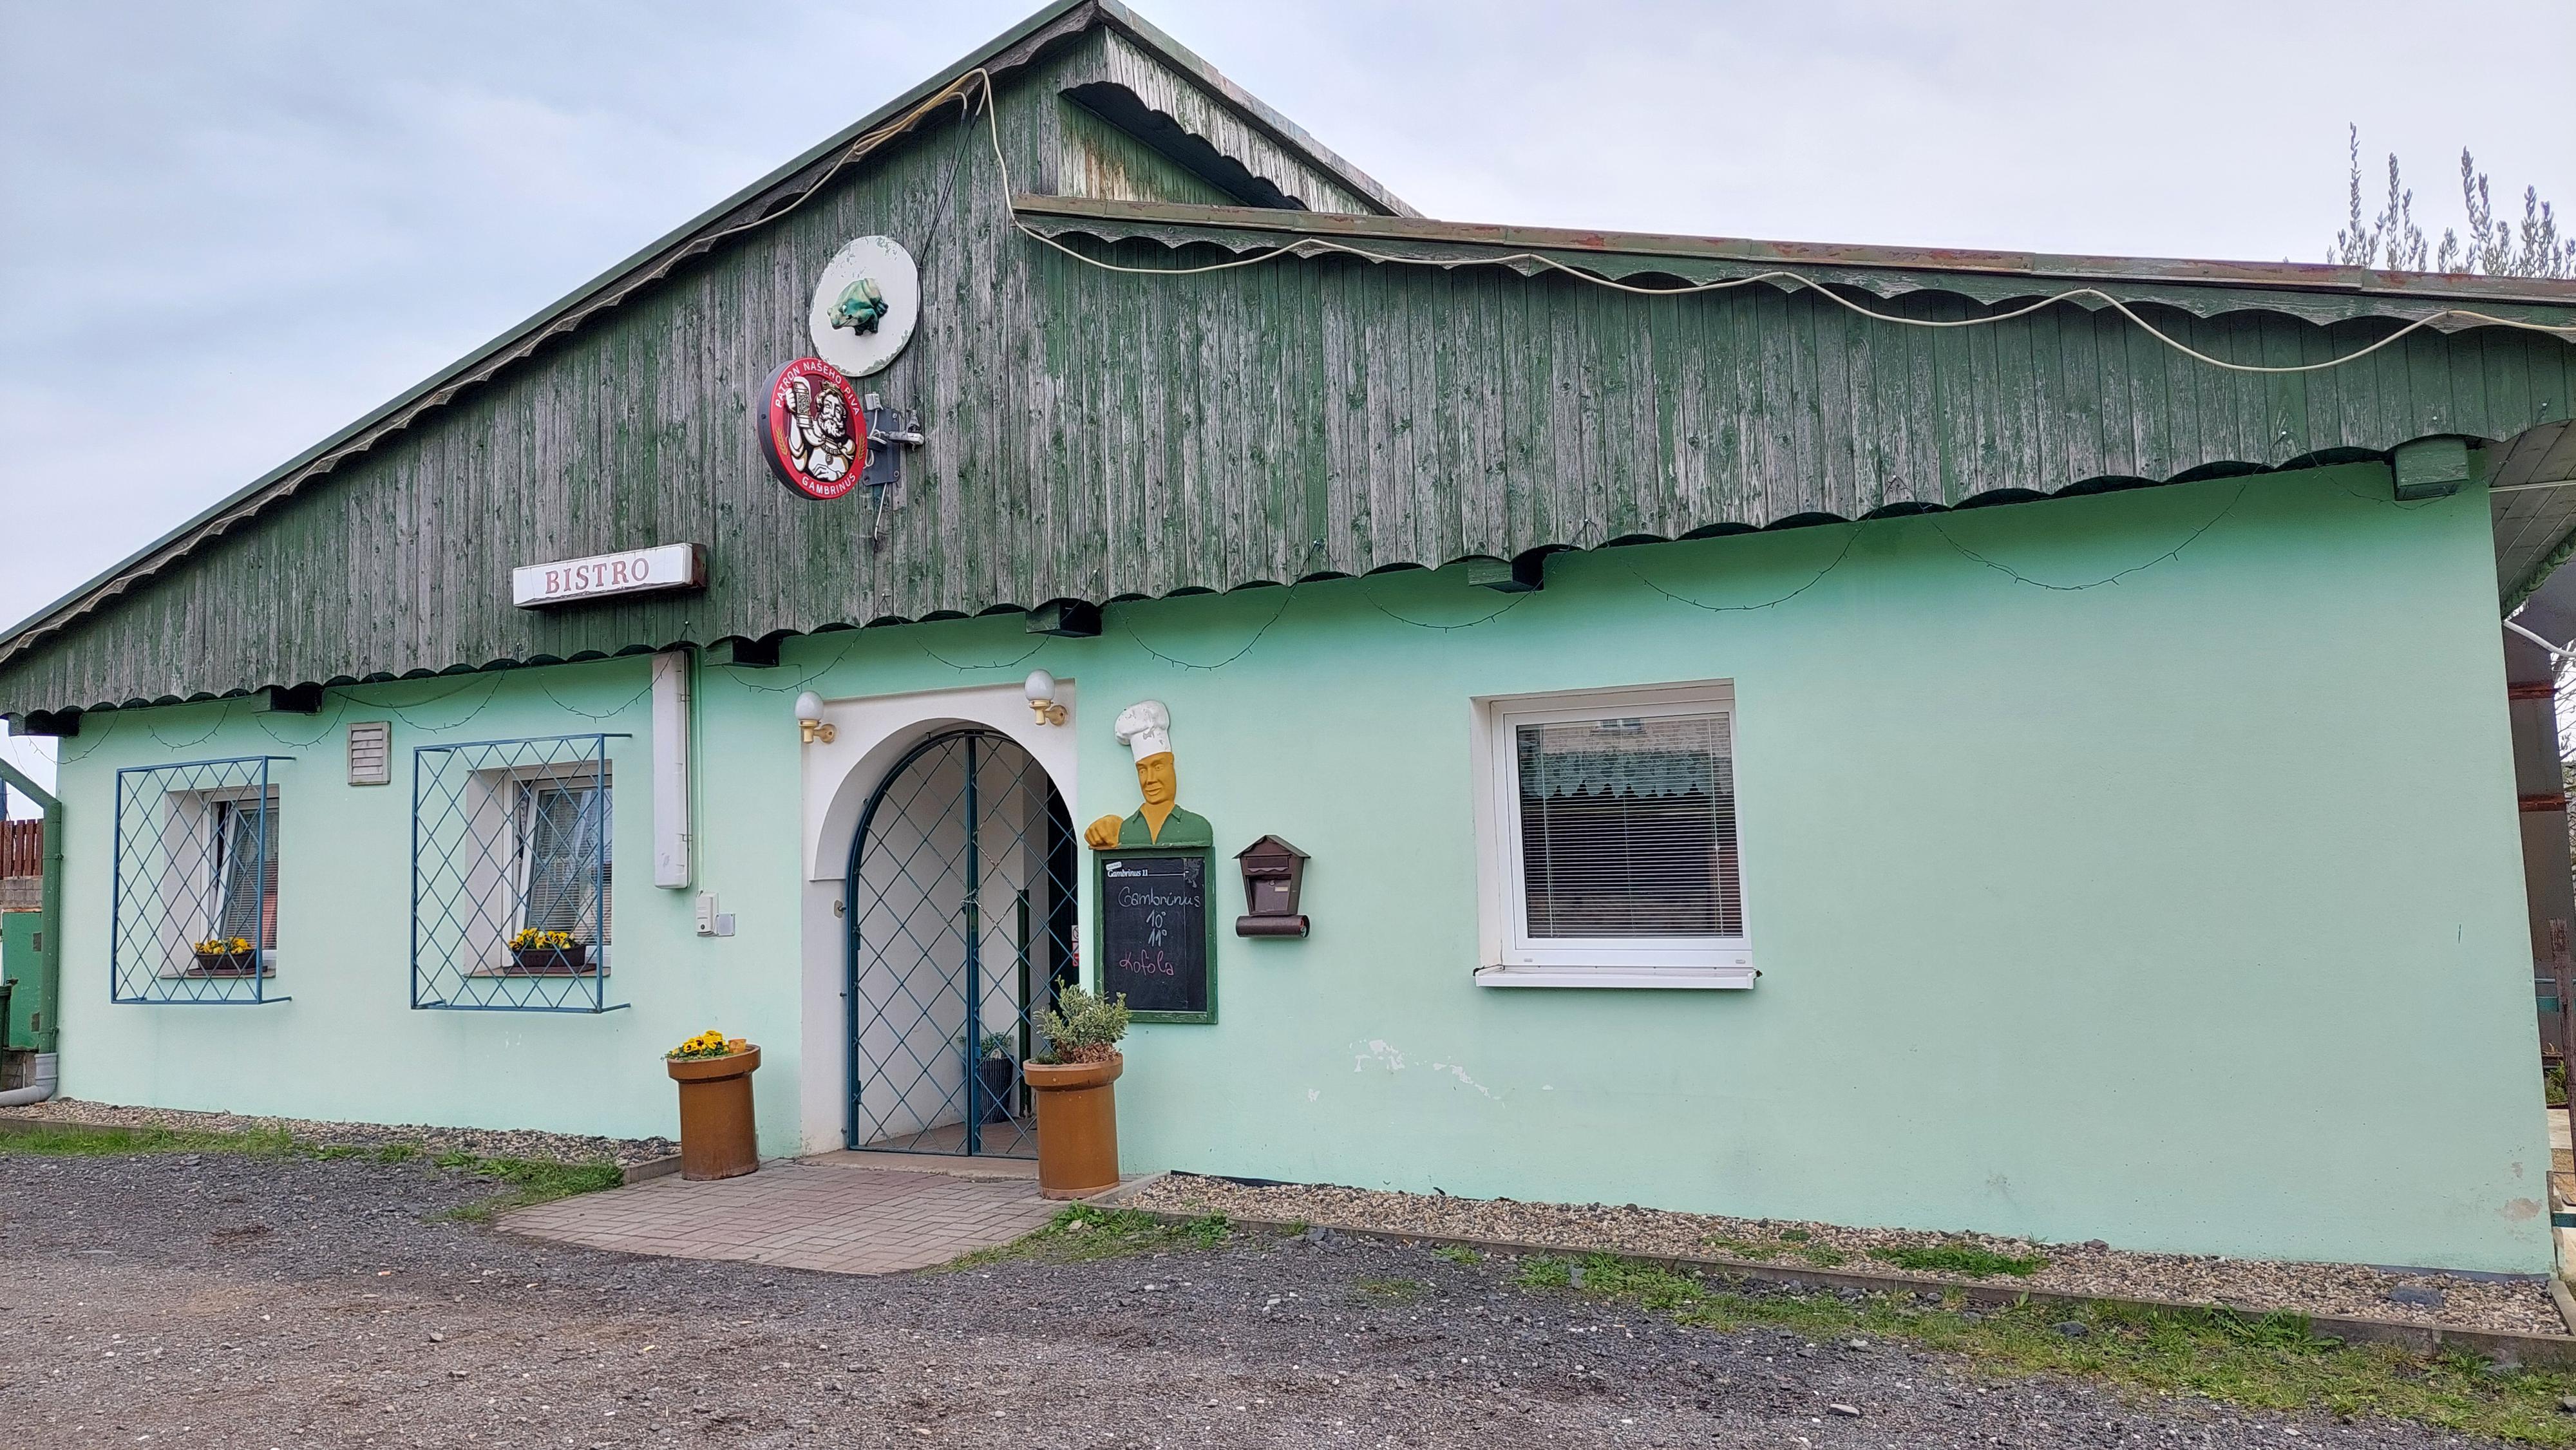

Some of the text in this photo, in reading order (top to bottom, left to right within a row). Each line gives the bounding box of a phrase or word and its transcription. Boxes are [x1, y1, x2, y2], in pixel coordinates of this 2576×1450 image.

[775, 360, 860, 416] PATRON NAŠEHO PIVA
[802, 473, 856, 495] GAMBRINUS
[545, 558, 649, 594] BISTRO
[1108, 869, 1141, 878] Gambrinus
[1118, 886, 1201, 907] Gambrinus
[1119, 949, 1174, 976] Kofola
